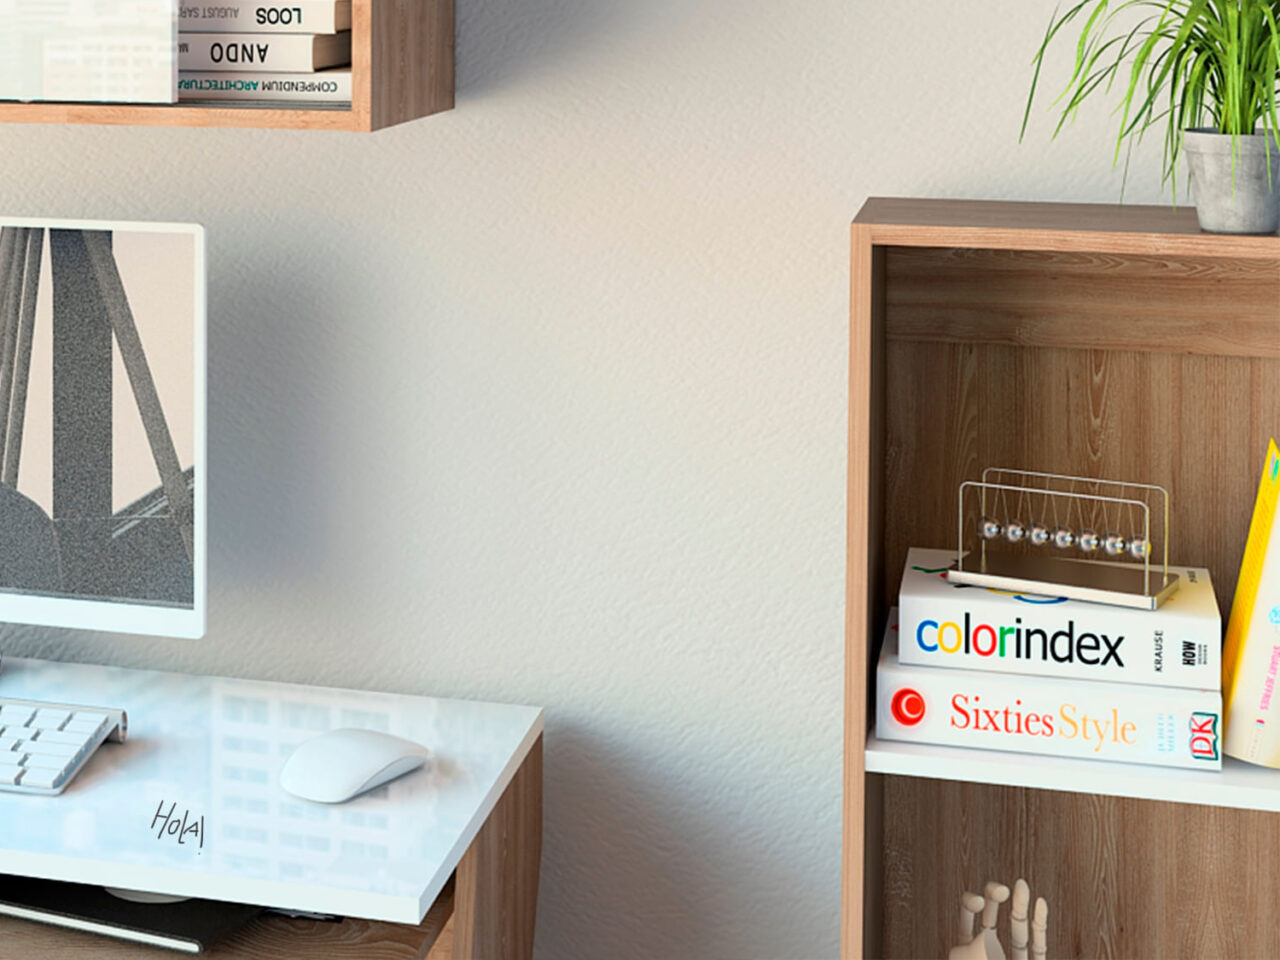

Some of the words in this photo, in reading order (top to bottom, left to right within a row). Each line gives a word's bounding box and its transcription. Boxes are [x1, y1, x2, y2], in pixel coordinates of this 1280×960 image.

[202, 7, 240, 19] AUGUST
[256, 7, 302, 25] LOOS
[210, 42, 269, 64] ANDO
[262, 81, 338, 93] COMPENDIUM
[915, 611, 1126, 668] colorindex
[1153, 630, 1164, 673] KRAUSE
[1181, 639, 1197, 667] HOW
[950, 693, 1055, 738] Sixties
[1058, 703, 1138, 752] Style
[1190, 715, 1215, 757] DK
